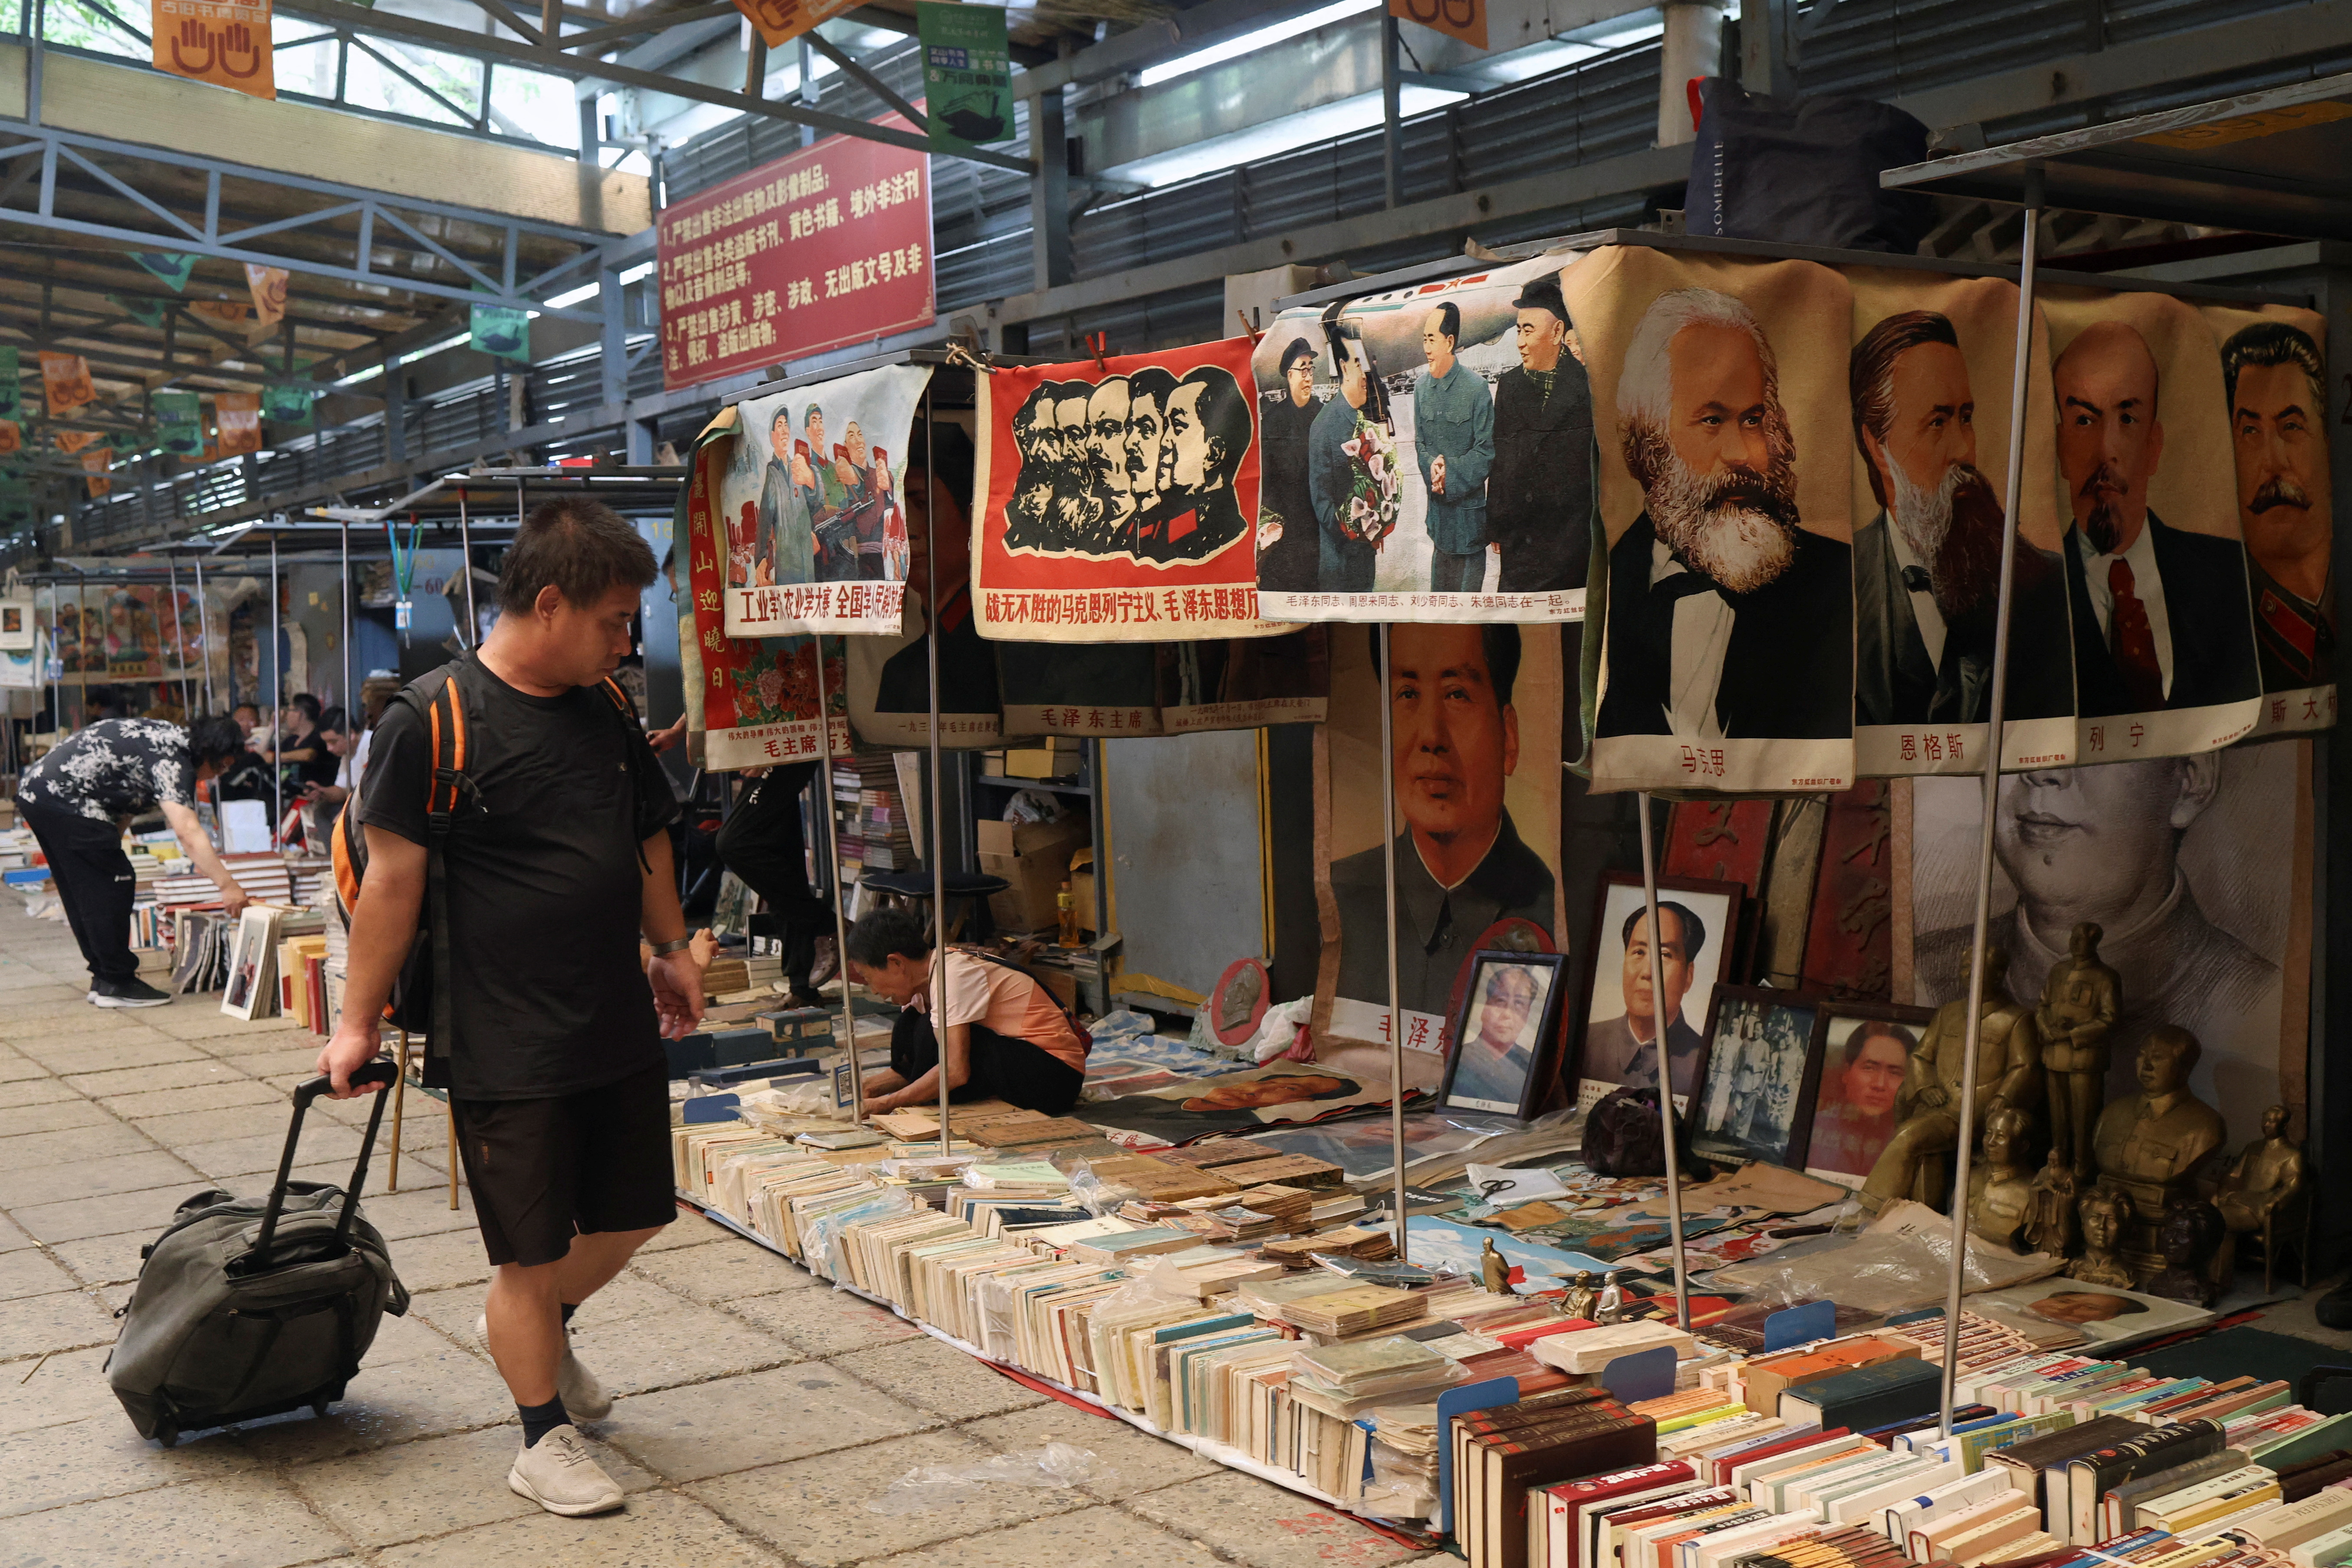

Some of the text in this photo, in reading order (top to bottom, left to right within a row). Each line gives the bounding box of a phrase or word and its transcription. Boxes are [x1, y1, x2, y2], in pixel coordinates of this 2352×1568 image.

[1286, 593, 1570, 609] 毛泽东同志、周恩来同志、刘少奇同志、朱德同志在一起。
[898, 720, 998, 734] 一九三年毛主席在陕北
[1041, 708, 1143, 729] 毛泽东主席
[2090, 722, 2144, 751] 列宁
[1900, 733, 1964, 762] 恩格斯
